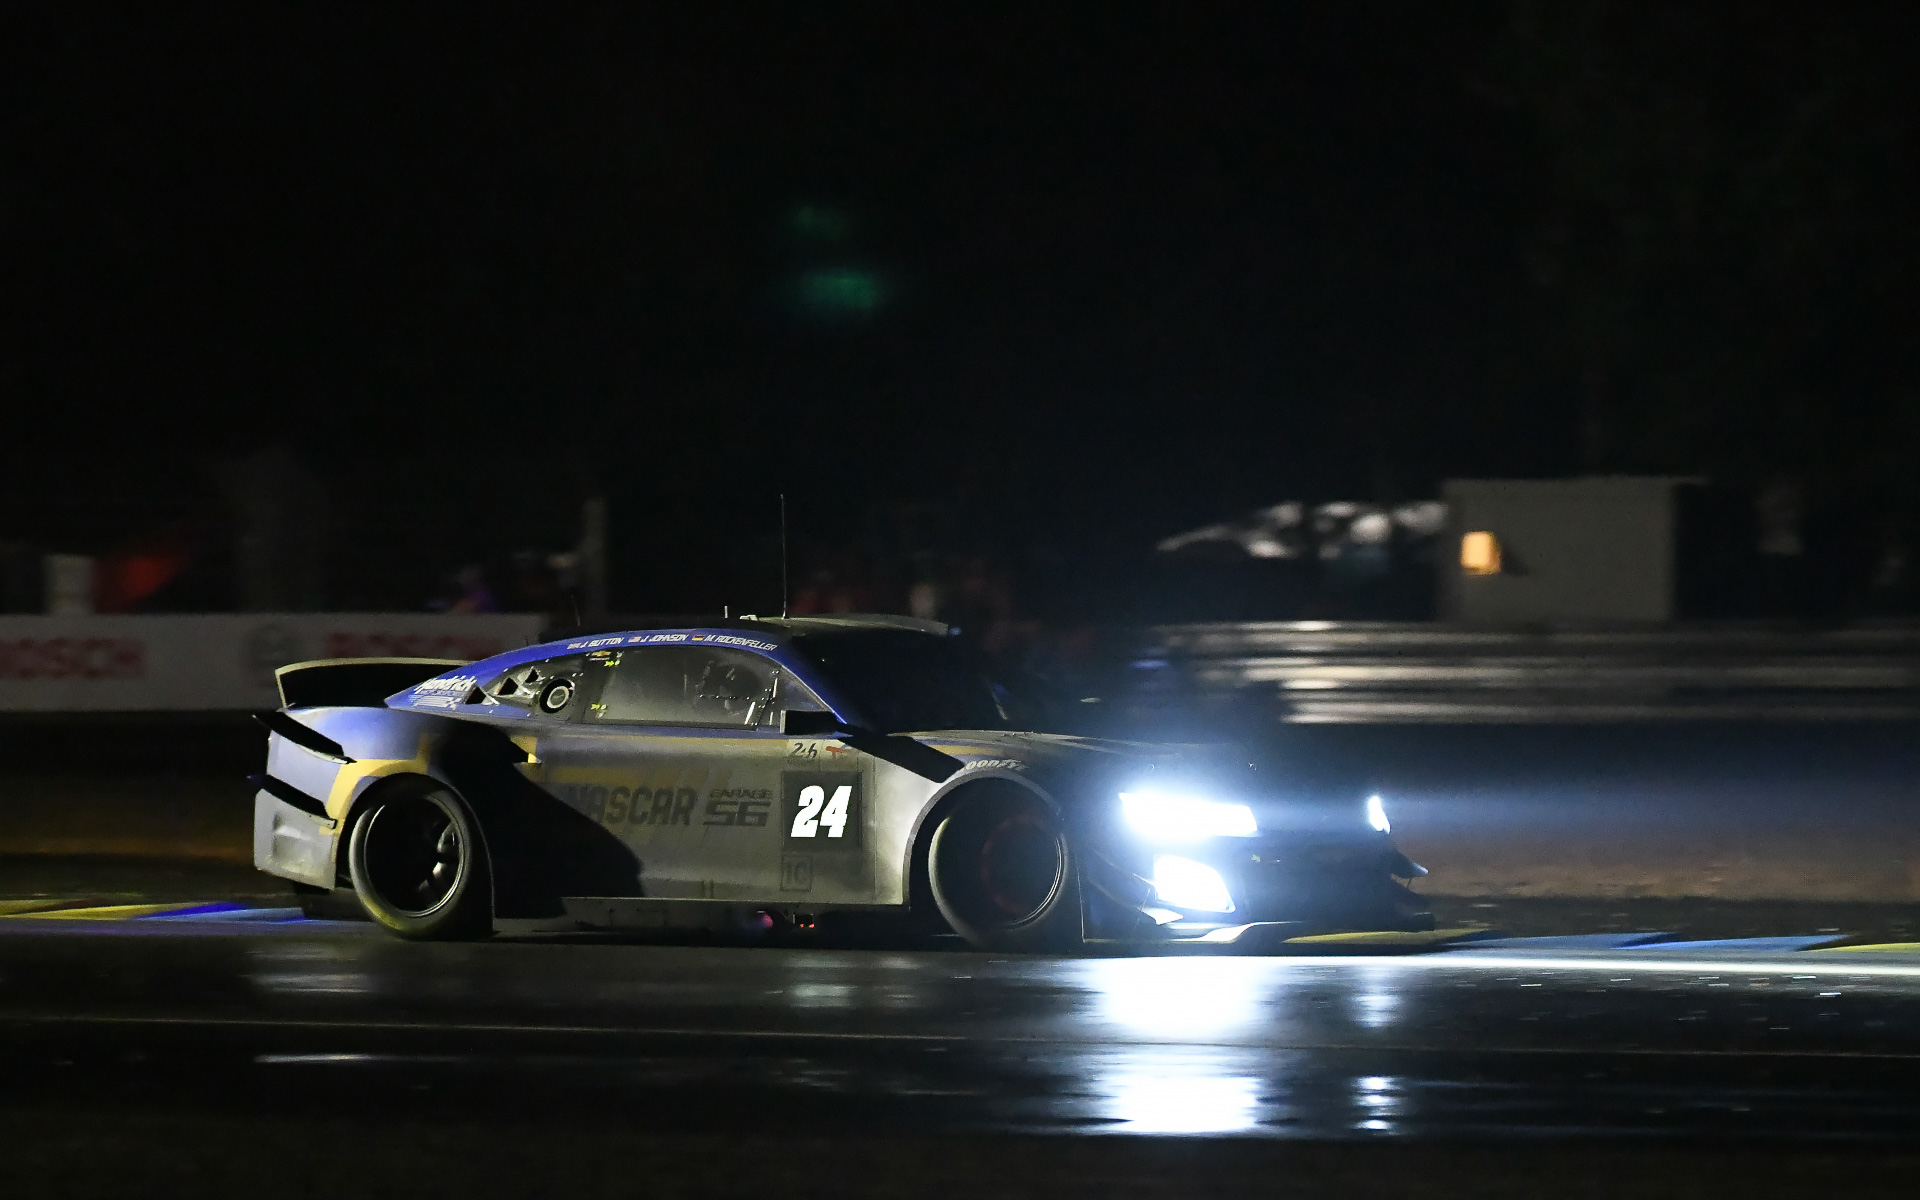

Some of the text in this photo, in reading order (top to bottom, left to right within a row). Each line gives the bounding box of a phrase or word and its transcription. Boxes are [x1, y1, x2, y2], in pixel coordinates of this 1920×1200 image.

[588, 637, 624, 647] BUTTON
[649, 634, 689, 642] JOHNSON
[716, 635, 778, 651] ROCKENFELLER
[709, 788, 773, 799] GARAGE
[703, 801, 772, 827] 56
[790, 785, 853, 838] 24
